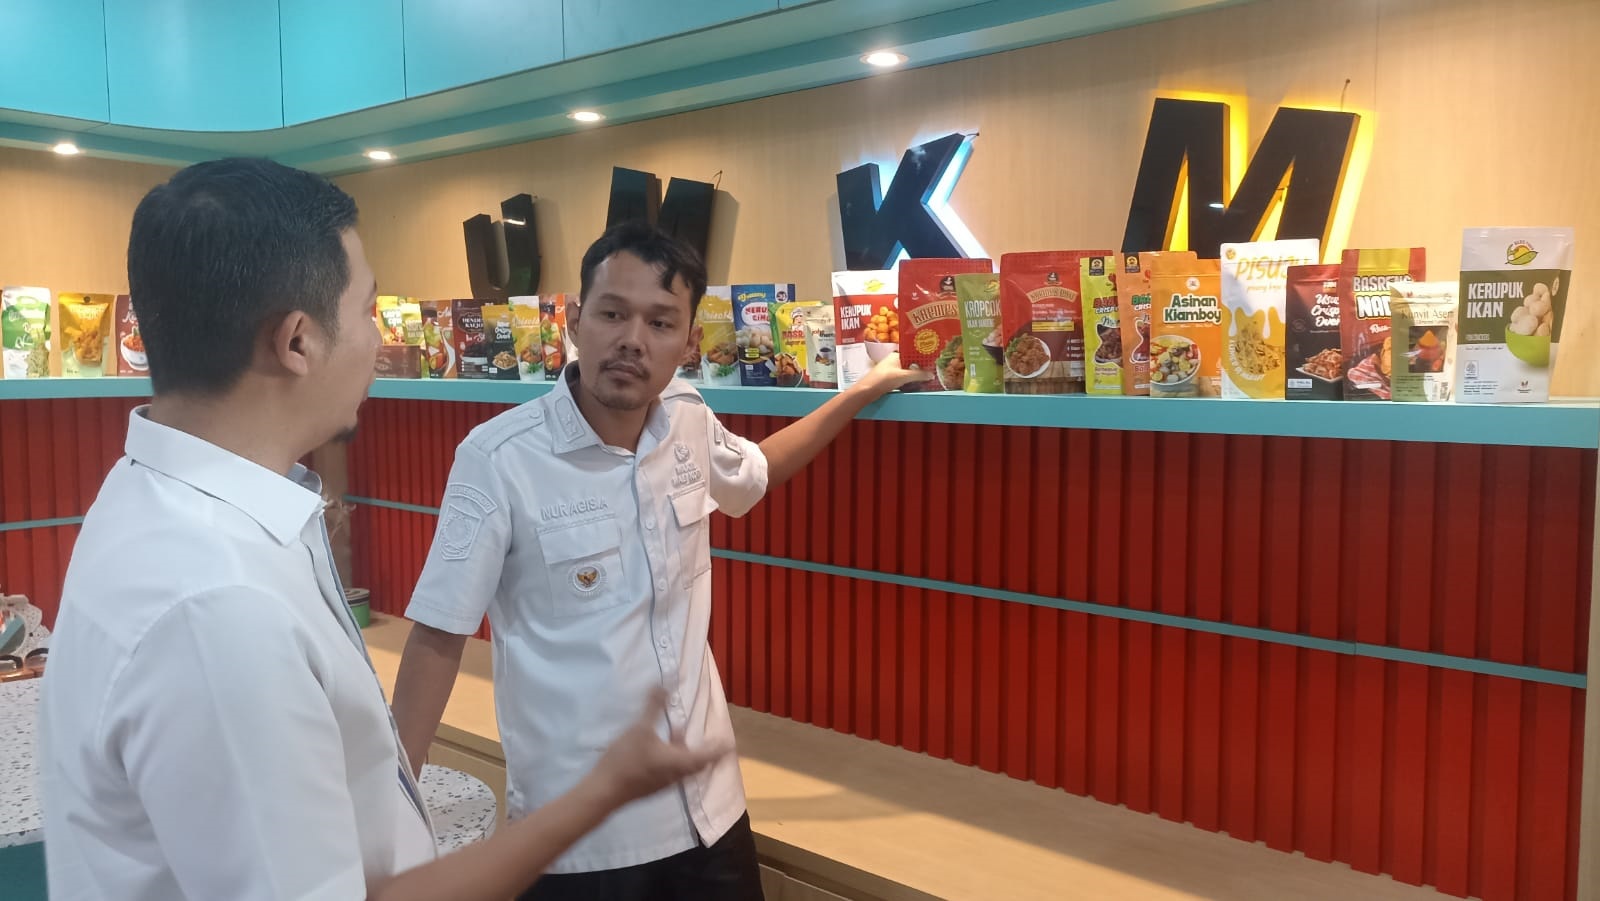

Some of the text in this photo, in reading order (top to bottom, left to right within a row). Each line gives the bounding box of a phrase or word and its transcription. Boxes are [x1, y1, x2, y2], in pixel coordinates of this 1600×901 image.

[1468, 281, 1525, 300] KERUPUK
[1171, 294, 1217, 308] Asinan
[840, 303, 872, 319] KERUPUK
[1466, 301, 1504, 319] IKAN
[841, 317, 860, 331] IKAN
